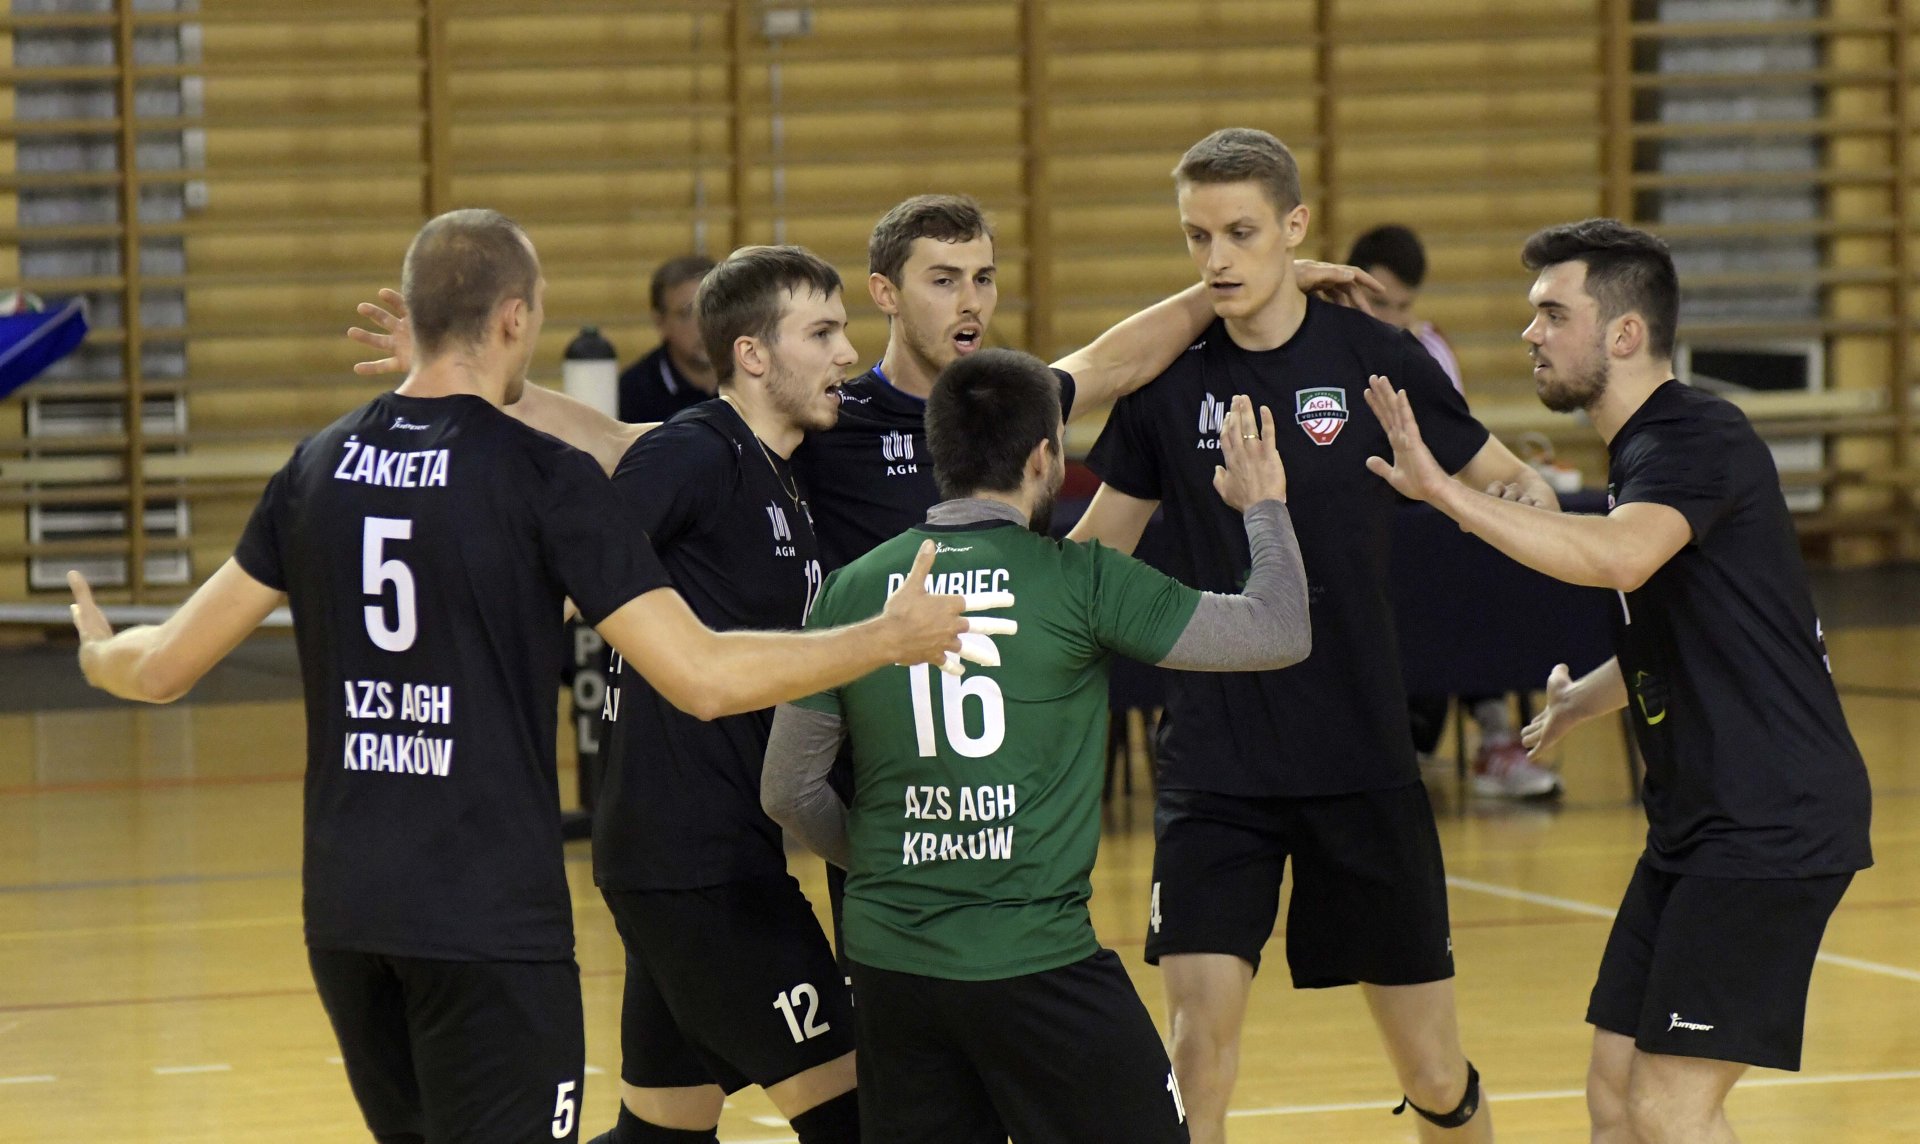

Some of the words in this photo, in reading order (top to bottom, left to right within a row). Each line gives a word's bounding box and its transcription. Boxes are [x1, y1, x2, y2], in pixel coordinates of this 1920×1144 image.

[1309, 400, 1333, 409] AGH
[334, 435, 451, 488] ŻAKIETA
[886, 463, 918, 477] AGH
[774, 545, 797, 558] AGH
[361, 516, 417, 653] 5
[886, 568, 1011, 599] DMBIEC
[343, 680, 396, 720] AZS
[400, 683, 452, 725] AGH
[894, 630, 1006, 759] 16
[343, 730, 453, 777] KRAKÓW
[904, 785, 953, 821] AZS
[959, 784, 1016, 822] AGH
[773, 982, 831, 1044] 12
[551, 1080, 576, 1139] 5
[1166, 1066, 1187, 1126] 1
